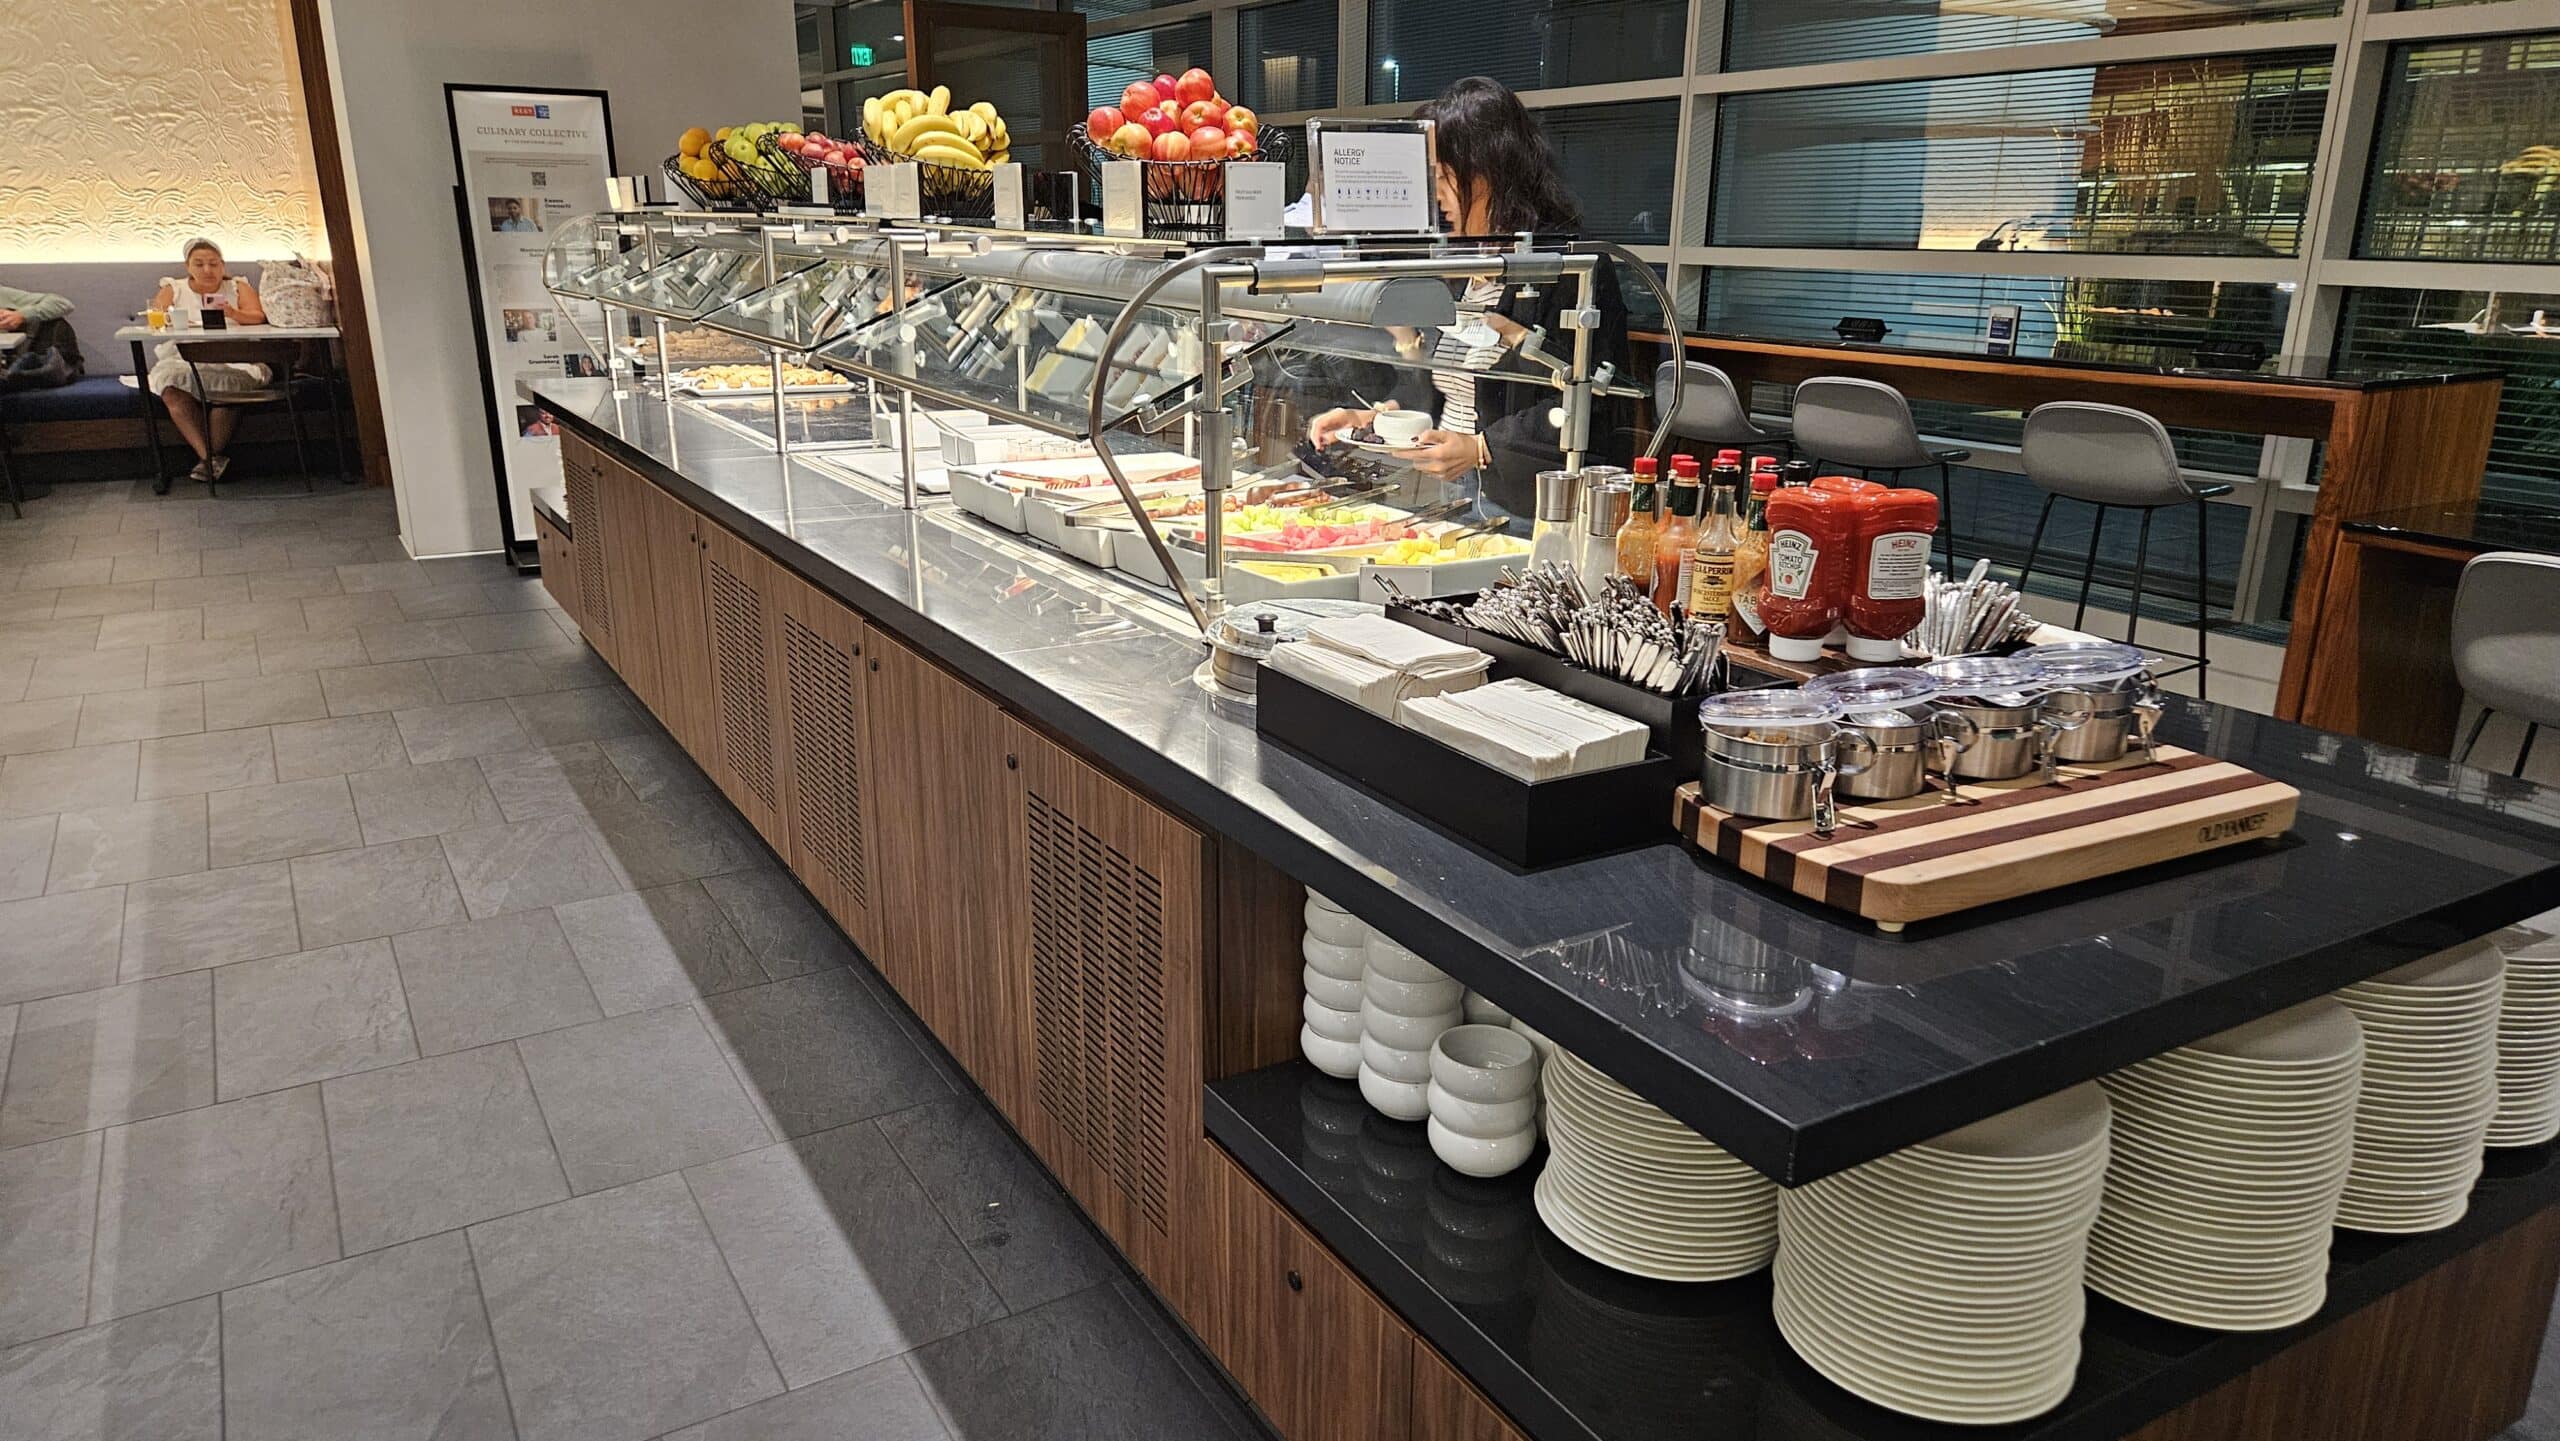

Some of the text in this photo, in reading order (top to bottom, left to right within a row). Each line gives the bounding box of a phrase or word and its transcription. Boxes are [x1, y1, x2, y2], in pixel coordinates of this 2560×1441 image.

[476, 126, 588, 139] CULINARY COLLECTIVE
[1334, 148, 1365, 157] ALLERGY
[1335, 157, 1360, 165] NOTICE
[1780, 540, 1802, 551] HEINZ
[1891, 539, 1917, 549] HEINZ
[1778, 553, 1803, 564] TOMATO
[1708, 566, 1733, 575] PERRIN
